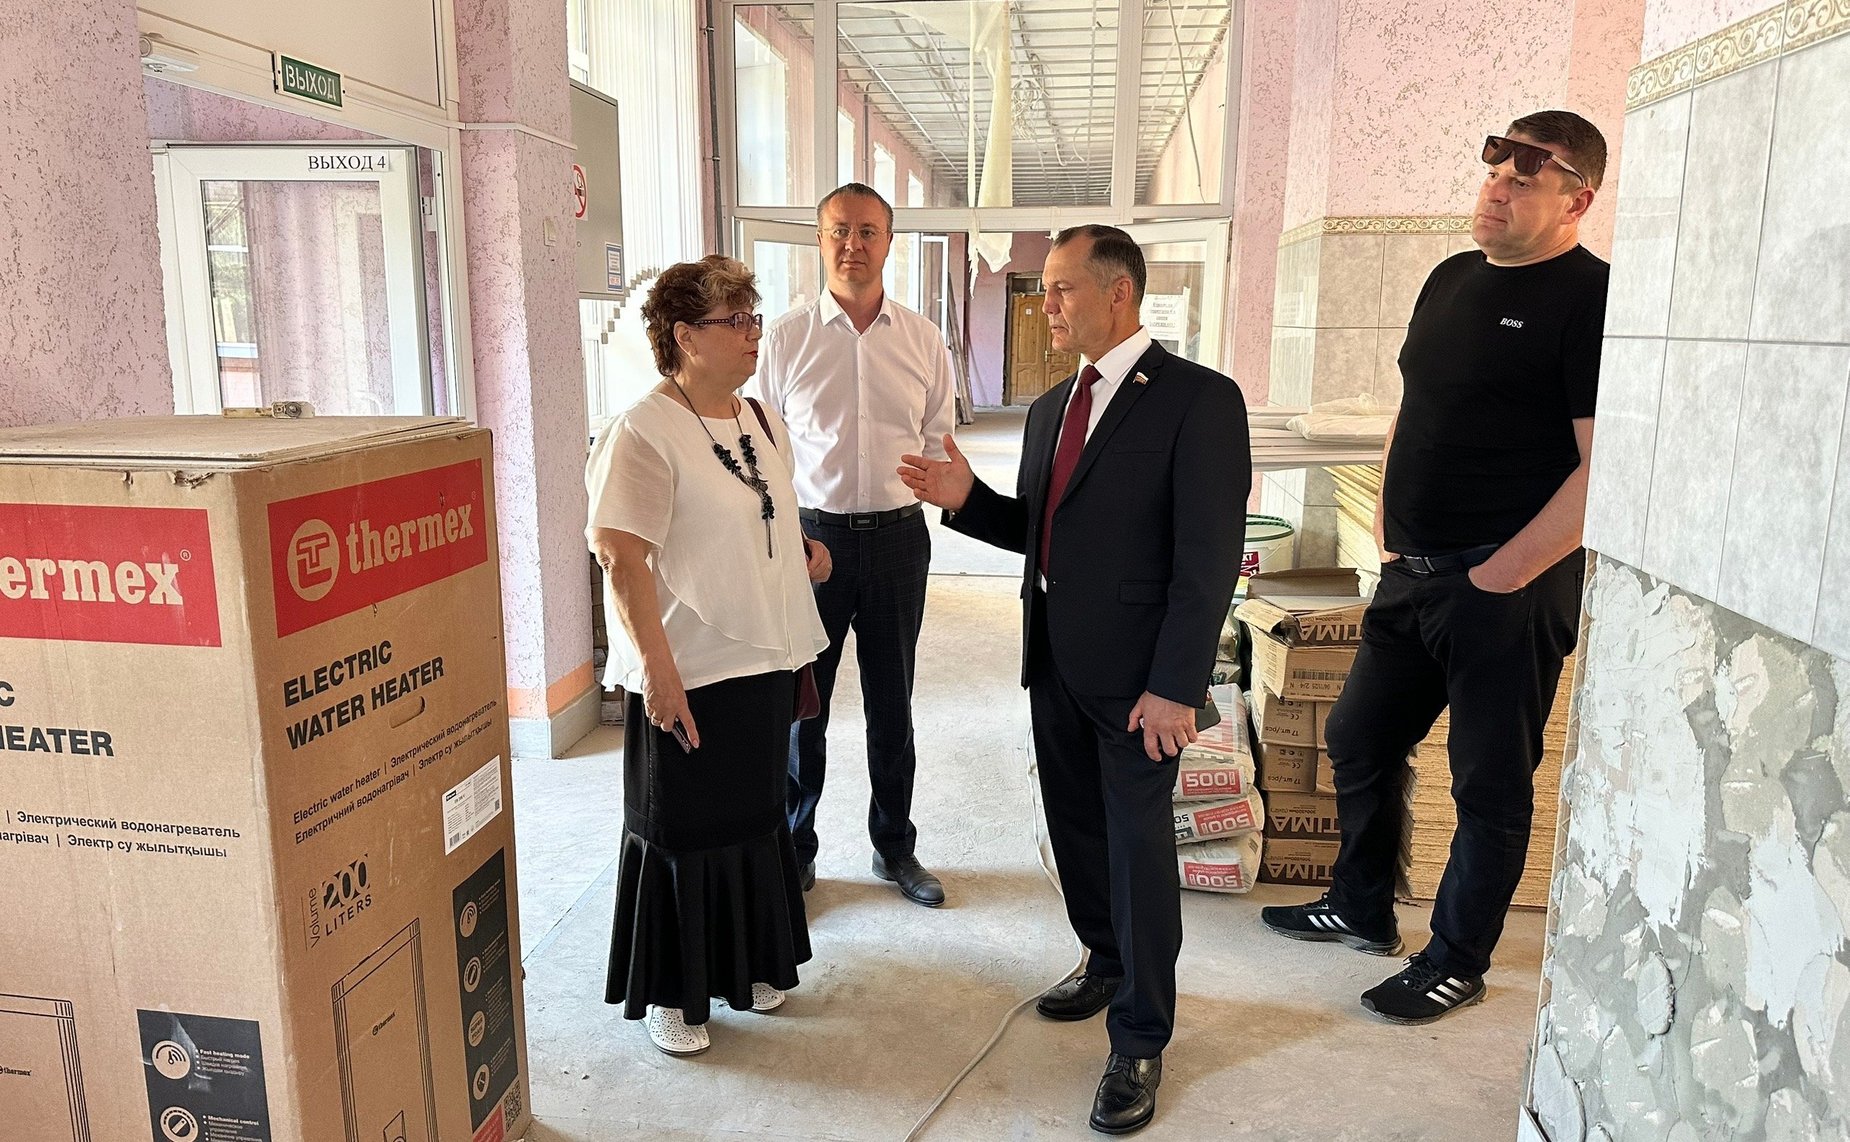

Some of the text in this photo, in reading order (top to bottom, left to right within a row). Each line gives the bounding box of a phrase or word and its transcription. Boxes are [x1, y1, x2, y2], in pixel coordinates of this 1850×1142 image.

[285, 64, 337, 102] ВЫХОД
[308, 155, 386, 171] ВЫХОД 4
[1500, 317, 1524, 329] BOSS
[346, 503, 473, 575] thermex
[284, 640, 393, 708] ELECTRIC
[286, 656, 444, 750] WATER HEATER
[390, 728, 446, 768] Электрический
[418, 749, 444, 770] Электр
[444, 743, 453, 755] су
[293, 768, 381, 824] Electric water heater
[1185, 772, 1228, 788] 500
[17, 810, 241, 838] Электрический водонагреватель
[295, 801, 355, 845] Електричний
[356, 769, 410, 807] водонагрівач
[1207, 813, 1250, 834] 500
[67, 834, 113, 850] Электр
[117, 841, 132, 852] су
[321, 852, 371, 910] 200
[1196, 874, 1238, 887] 500
[308, 887, 320, 949] Volume
[325, 893, 372, 937] LITERS
